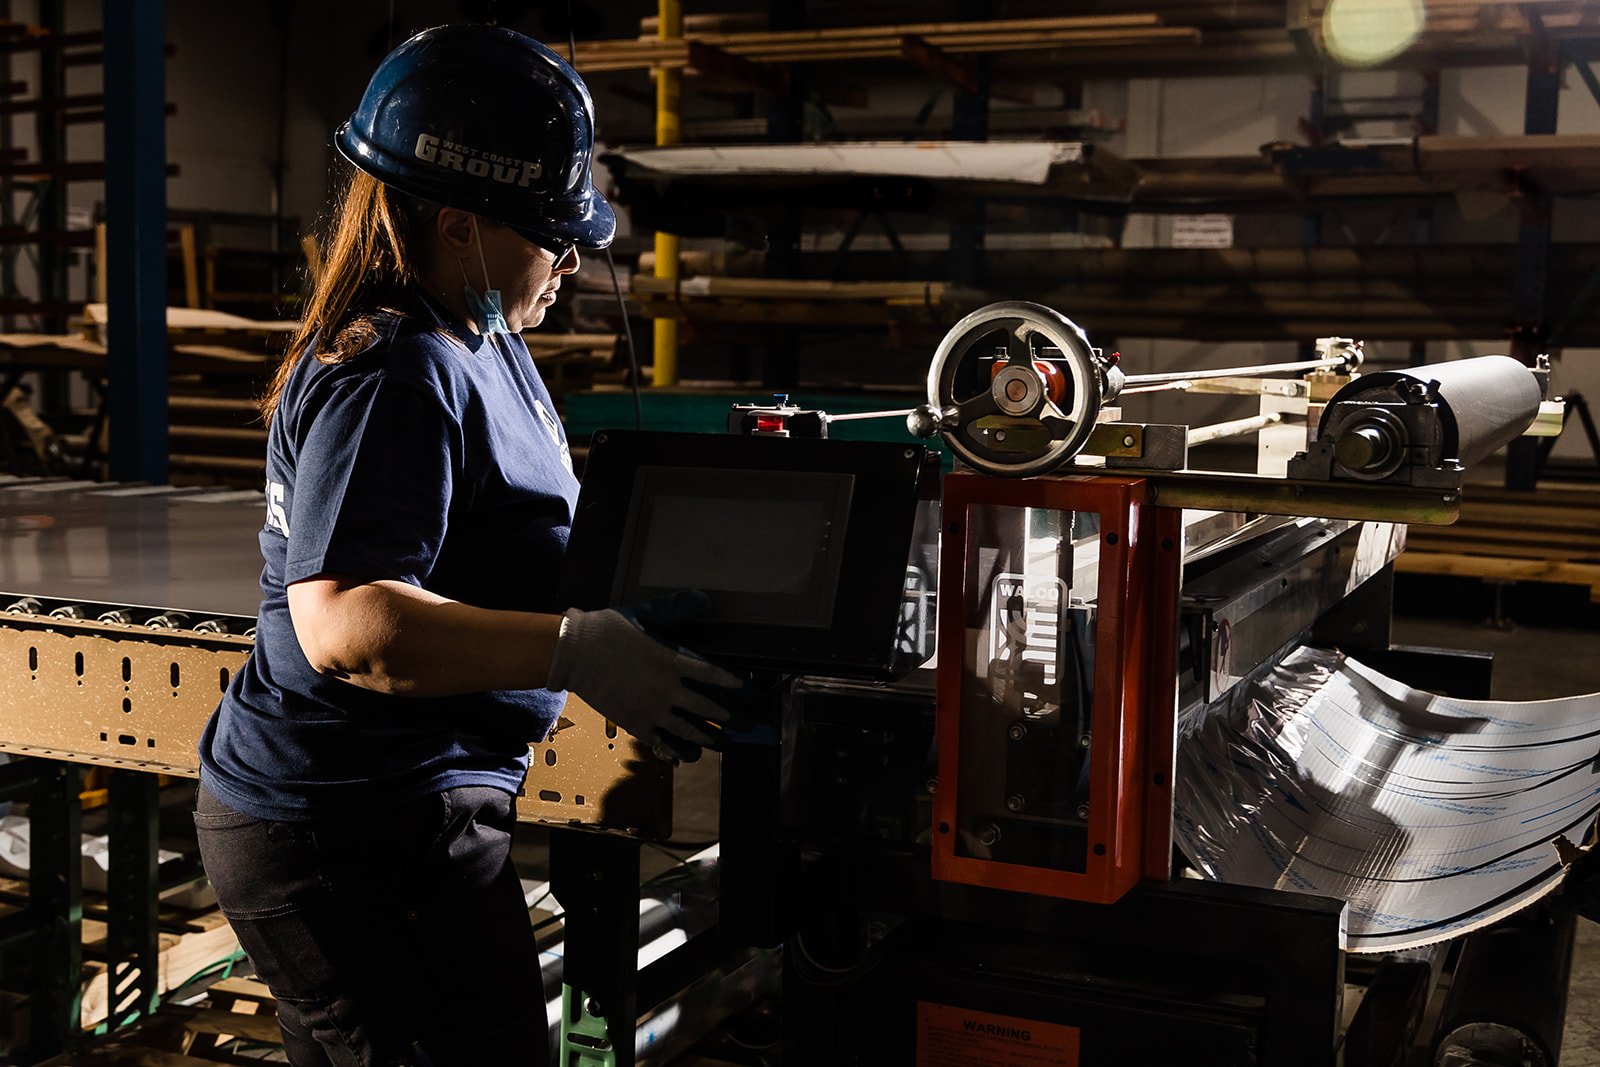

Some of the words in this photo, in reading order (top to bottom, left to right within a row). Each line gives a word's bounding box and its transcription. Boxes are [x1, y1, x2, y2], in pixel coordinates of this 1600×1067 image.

[414, 133, 543, 187] GROUP
[442, 140, 479, 156] WEST
[482, 151, 521, 167] COAST
[963, 1019, 1032, 1041] WARNING
